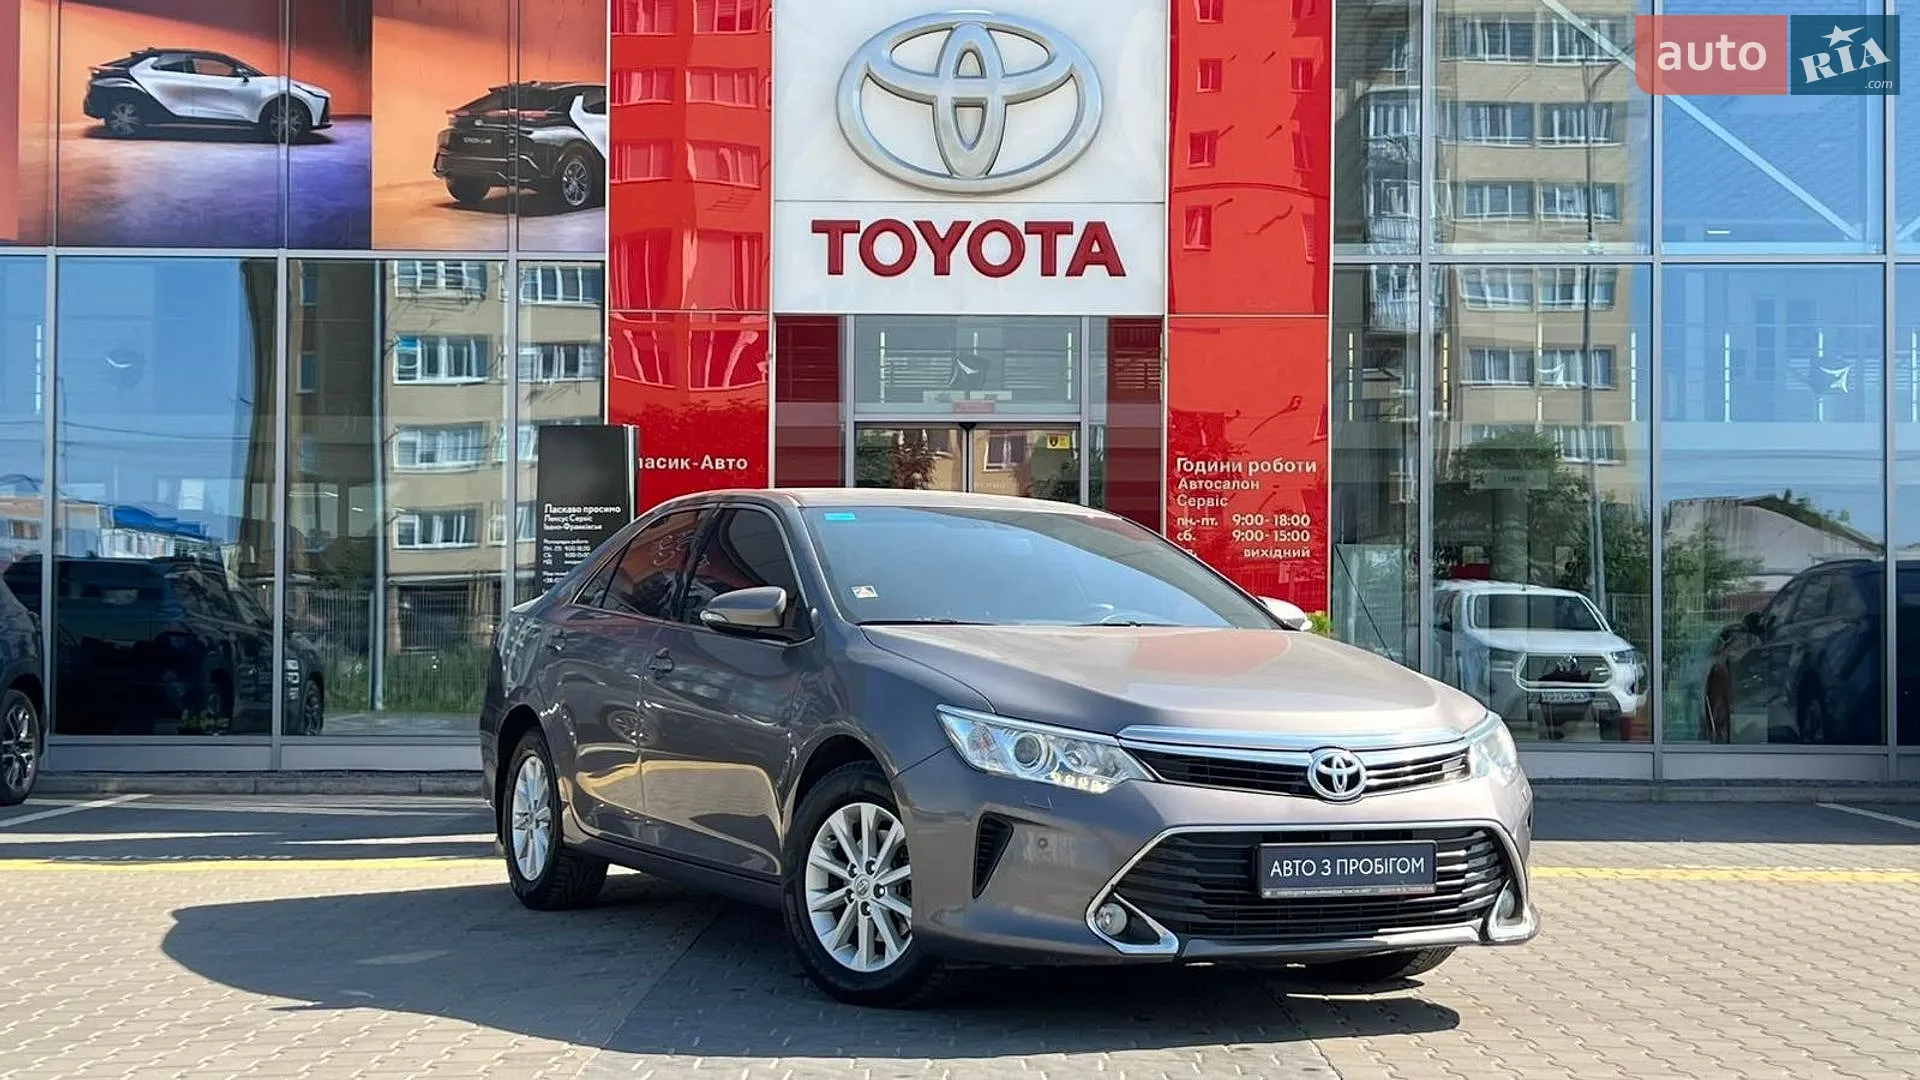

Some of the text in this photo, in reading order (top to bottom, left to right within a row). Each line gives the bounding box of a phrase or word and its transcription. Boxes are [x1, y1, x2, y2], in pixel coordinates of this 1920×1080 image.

[811, 218, 1127, 278] TOYOTA
[1176, 458, 1317, 475] Години роботи
[1177, 478, 1260, 490] Автосалон
[1176, 494, 1229, 509] Сервіс
[544, 503, 621, 515] Ласкаво просимо
[1176, 529, 1197, 541] сб.
[1243, 547, 1311, 559] вихідний
[1270, 859, 1317, 877] АВТО
[1336, 857, 1425, 876] ПРОБІГОМ
